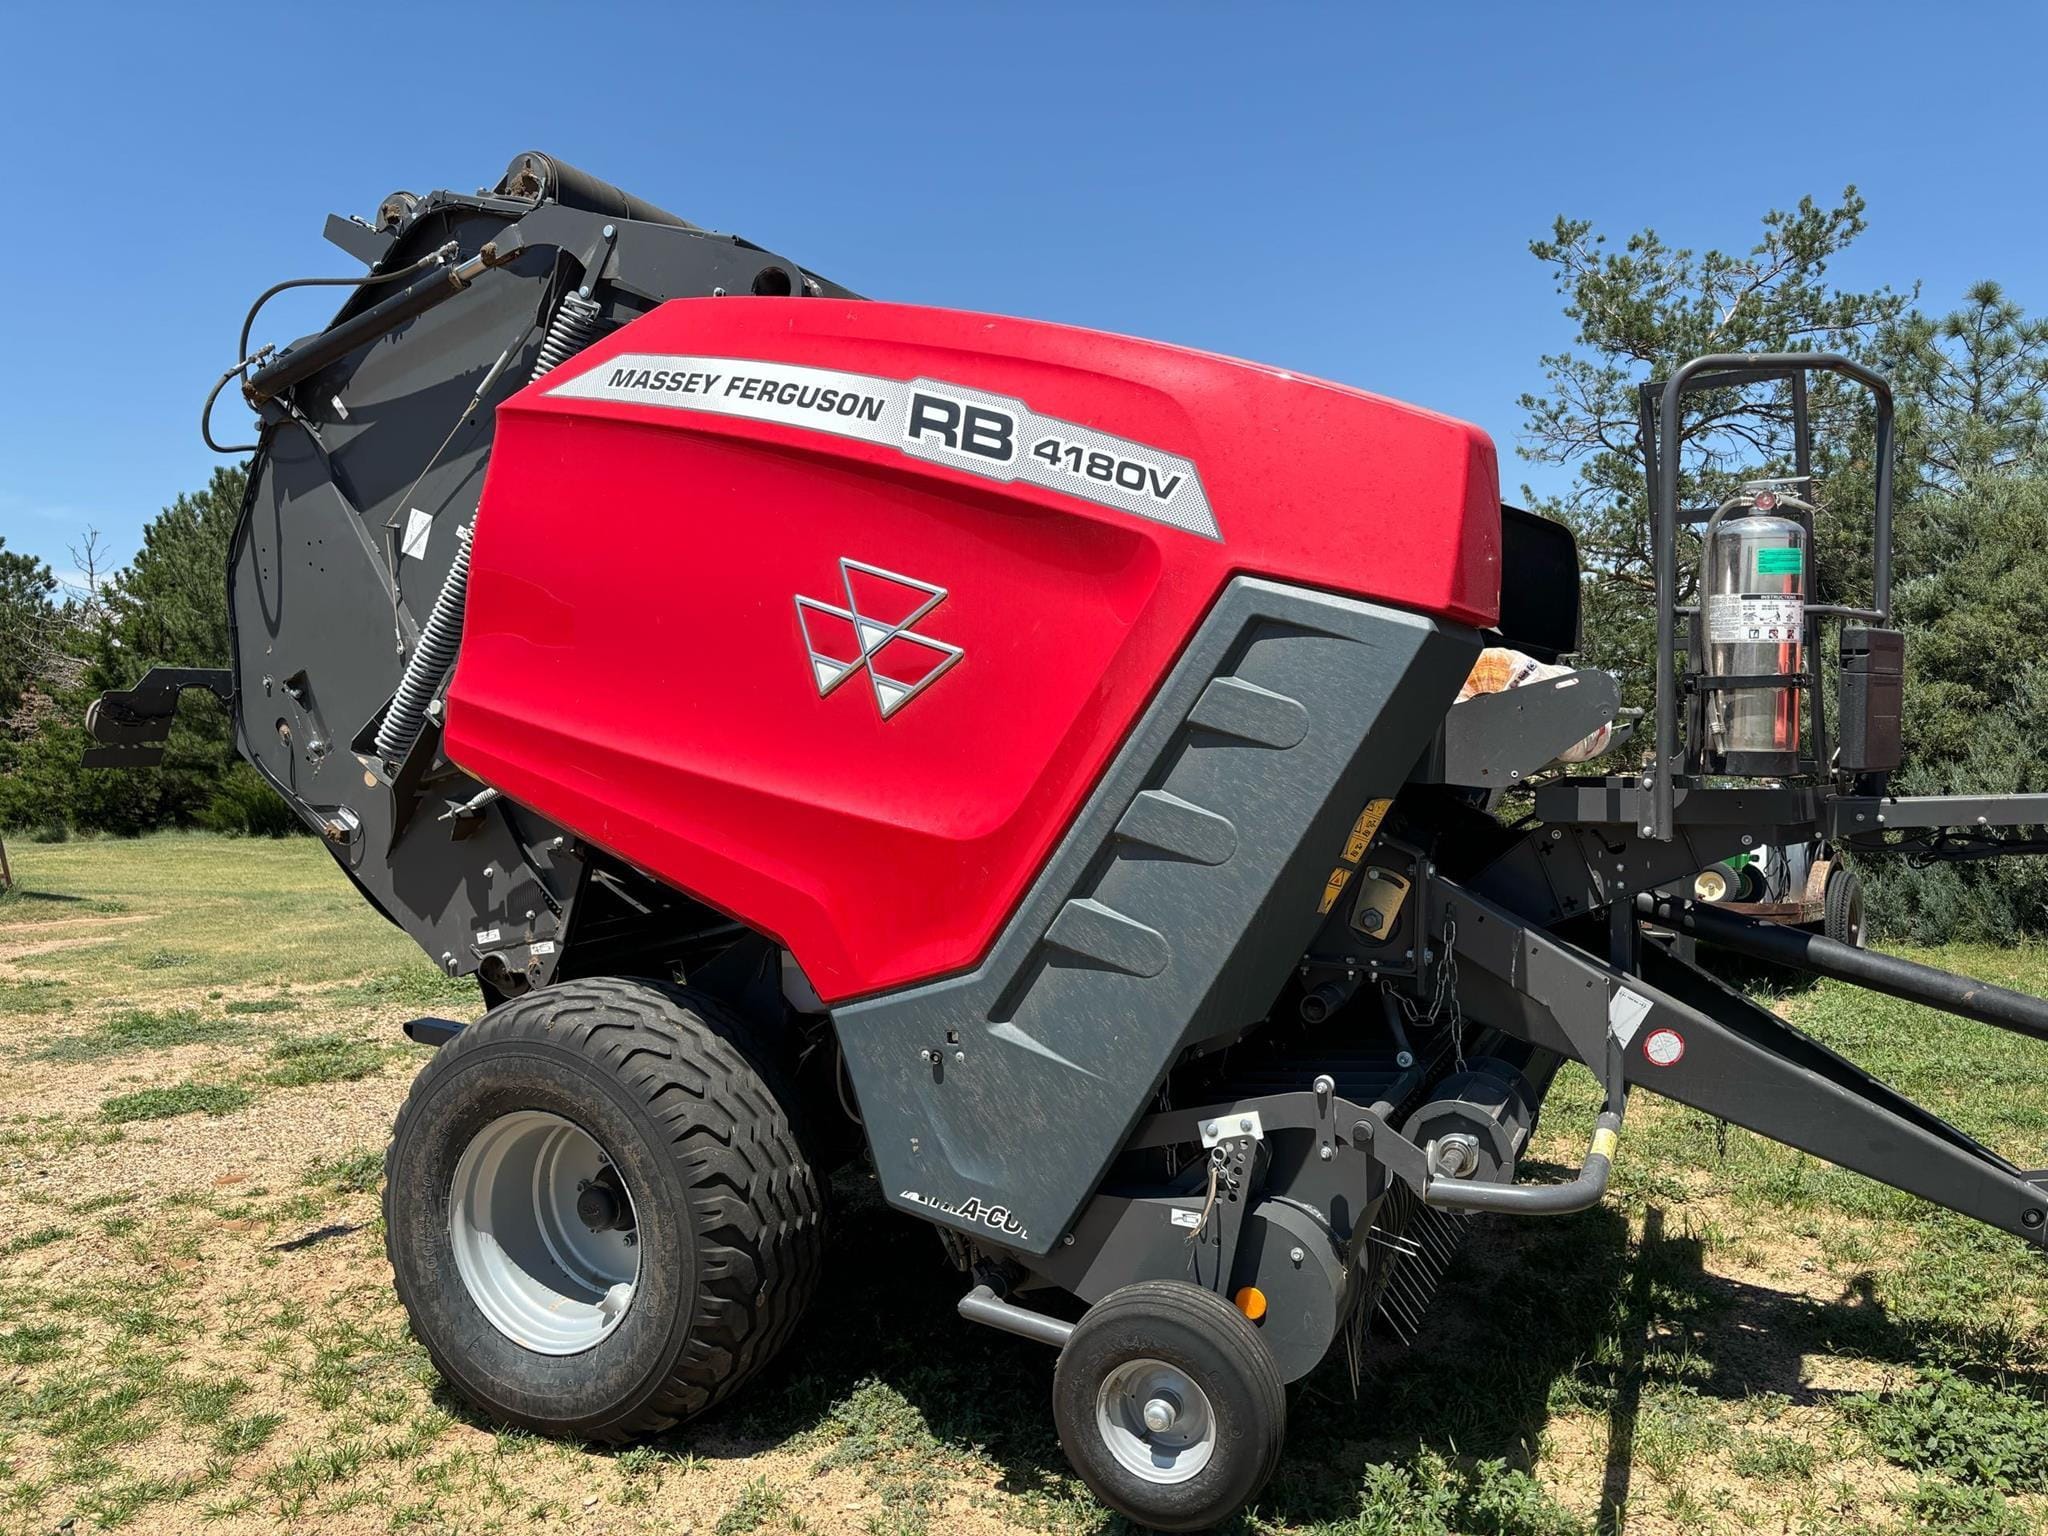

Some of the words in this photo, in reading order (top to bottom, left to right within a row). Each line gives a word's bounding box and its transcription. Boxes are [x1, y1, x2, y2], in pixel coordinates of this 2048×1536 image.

[608, 368, 722, 394] MASSEY
[723, 376, 885, 422] FERGUSON
[908, 392, 1014, 462] RB
[1033, 439, 1182, 500] 4180V
